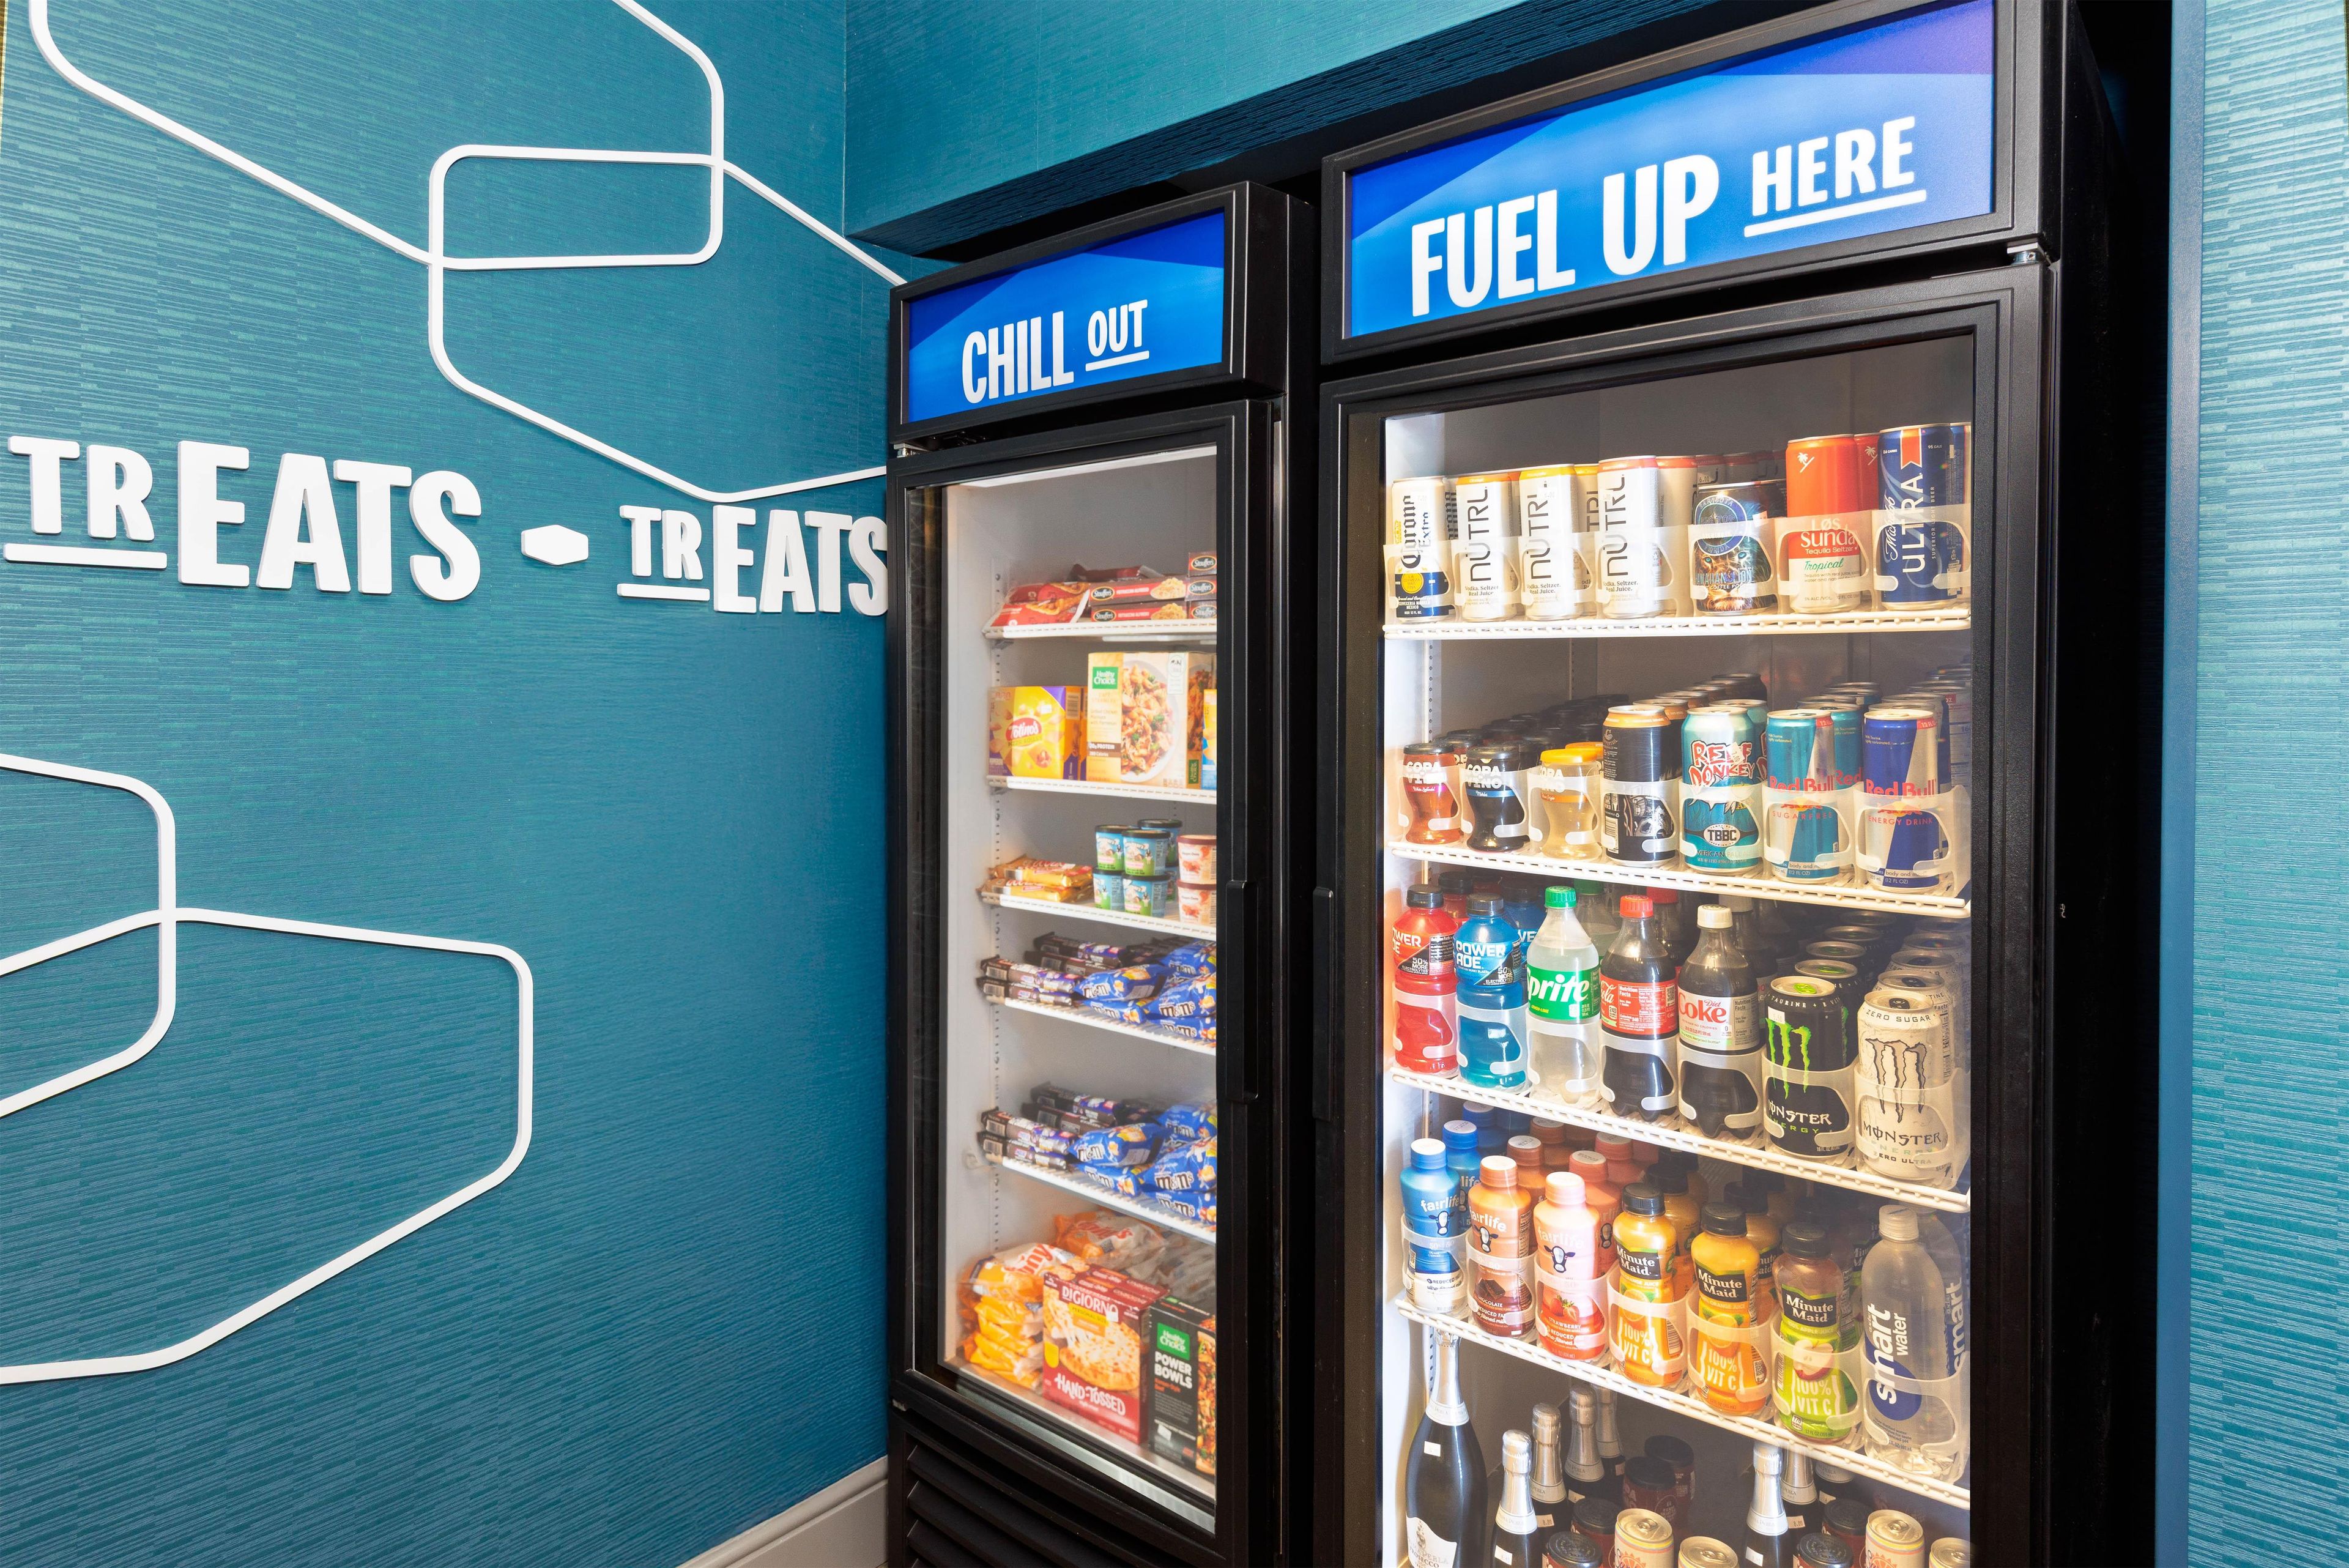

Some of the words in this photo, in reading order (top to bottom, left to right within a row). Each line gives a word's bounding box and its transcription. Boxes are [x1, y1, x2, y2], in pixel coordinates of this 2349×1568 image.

[1411, 189, 1575, 318] FUEL
[1602, 154, 1720, 277] UP
[1752, 116, 1915, 217] HERE
[962, 310, 1074, 404] CHILL
[1087, 299, 1148, 357] OUT
[8, 436, 482, 601] TREATS
[1900, 474, 1926, 573] ULTRA
[1400, 494, 1421, 570] Corona
[1417, 511, 1431, 549] Extra
[619, 505, 887, 617] TREATS
[1804, 557, 1844, 573] Tropical
[1094, 676, 1116, 685] Choice
[1407, 761, 1440, 773] COPA
[1468, 764, 1501, 777] COPA
[1688, 762, 1756, 789] DONKEY
[1468, 778, 1502, 789] VINO
[1769, 776, 1800, 791] Red
[1804, 775, 1834, 791] Bull
[1865, 779, 1898, 795] Red
[1902, 778, 1936, 797] Bull
[1868, 815, 1902, 825] ENERGY
[1906, 817, 1933, 826] DRINK
[1707, 828, 1737, 842] TBBC
[1456, 940, 1507, 957] POWER
[1412, 957, 1428, 965] 50%
[1678, 992, 1727, 1024] Coke
[1704, 998, 1721, 1008] Diet
[1771, 994, 1806, 1008] TAURINE
[1866, 1009, 1890, 1021] ZERO
[1768, 1099, 1832, 1125] MONSTER
[1863, 1120, 1942, 1145] MONSTER
[1616, 1244, 1655, 1267] Minute
[1620, 1260, 1649, 1276] Maid
[1433, 1276, 1455, 1285] REDUCED
[1698, 1269, 1743, 1289] Minute
[1703, 1283, 1737, 1298] Maid
[1785, 1292, 1834, 1312] Minute
[1548, 1316, 1581, 1329] STRAWBERRY
[1792, 1306, 1828, 1324] Maid
[1550, 1328, 1574, 1339] REDUCED
[1623, 1325, 1650, 1348] 100%
[1894, 1312, 1908, 1357] water
[1159, 1335, 1187, 1353] Choice
[1624, 1342, 1641, 1362] VIT
[1641, 1349, 1650, 1365] C
[1868, 1303, 1897, 1405] smart
[1154, 1350, 1192, 1377] POWER
[1708, 1348, 1737, 1373] 100%
[1154, 1362, 1193, 1389] BOWLS
[1707, 1365, 1724, 1387] VIT
[1729, 1375, 1737, 1389] C
[1054, 1373, 1126, 1416] HAND-TOSSED
[1795, 1378, 1831, 1395] 100%
[1796, 1396, 1822, 1416] VIT
[1824, 1397, 1833, 1416] C
